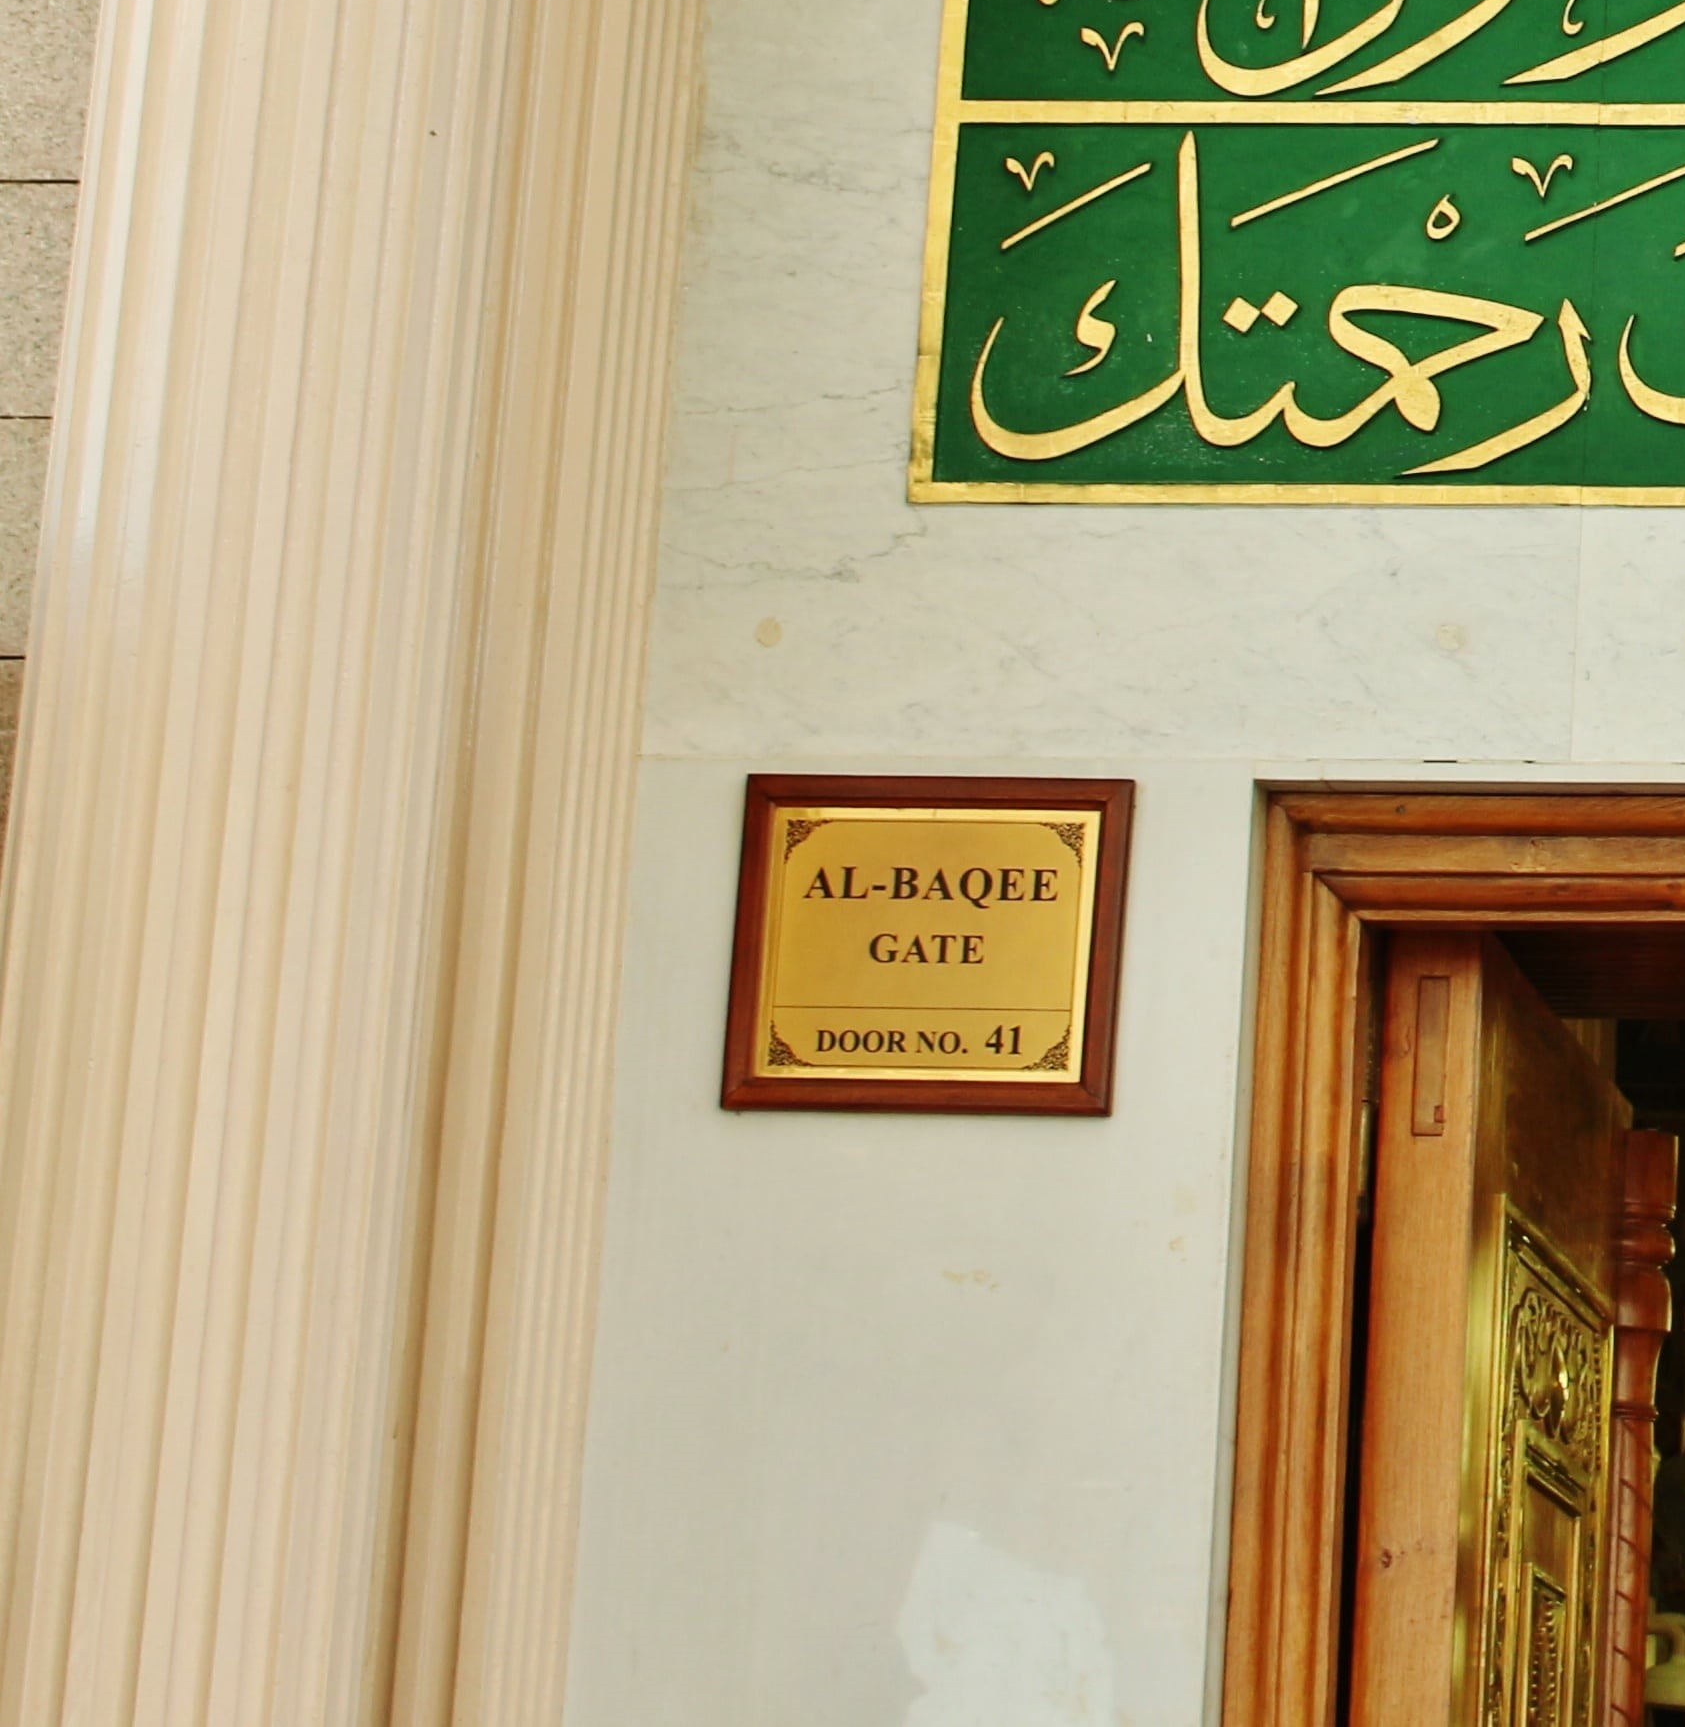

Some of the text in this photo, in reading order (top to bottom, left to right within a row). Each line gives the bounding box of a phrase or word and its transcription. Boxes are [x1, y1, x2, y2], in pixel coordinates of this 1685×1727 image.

[802, 865, 1059, 909] AL-BAQEE
[869, 933, 985, 965] GATE
[815, 1024, 1022, 1055] DOOR NO. 41
